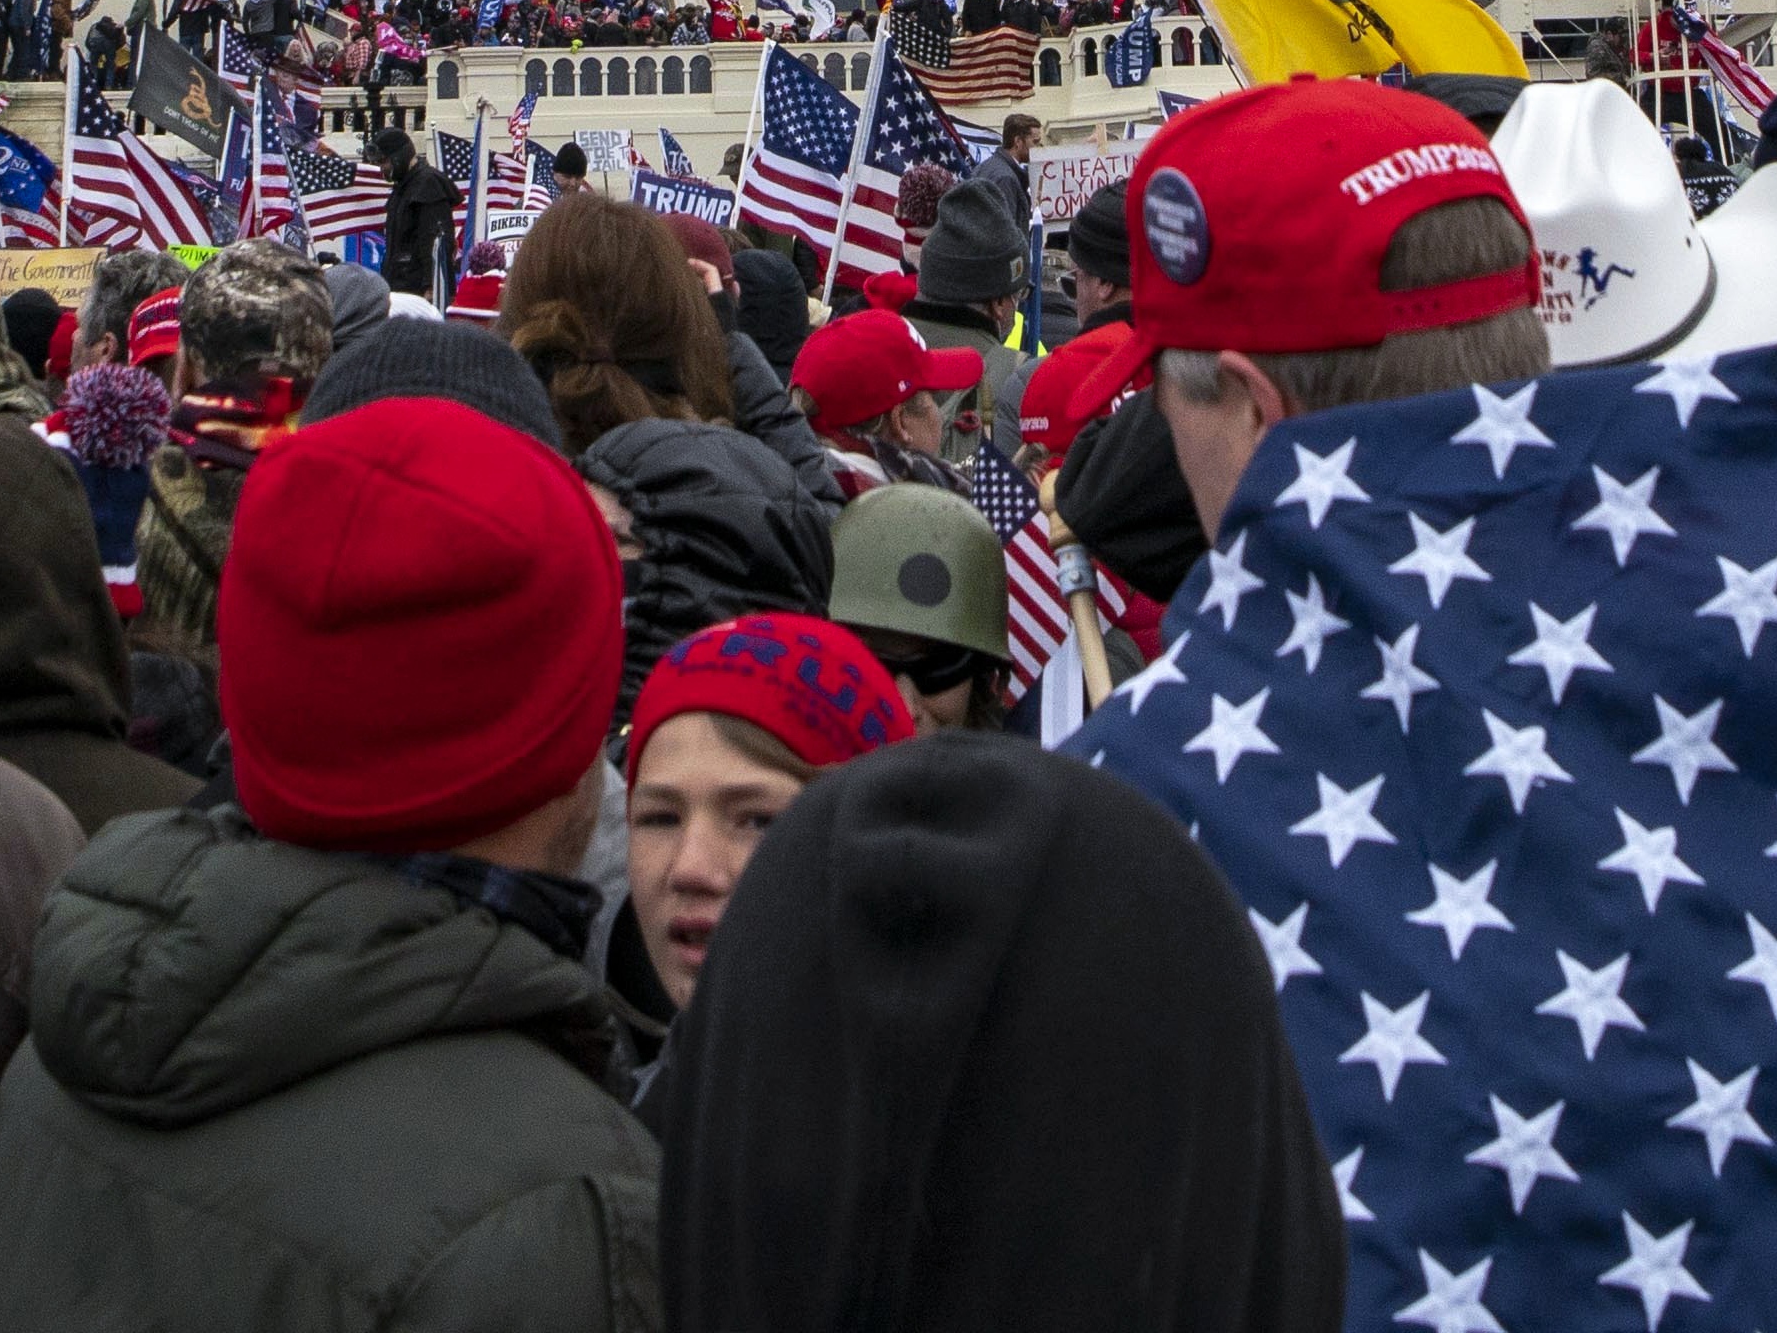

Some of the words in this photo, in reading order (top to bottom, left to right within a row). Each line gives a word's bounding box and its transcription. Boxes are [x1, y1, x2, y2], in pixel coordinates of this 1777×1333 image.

[579, 130, 623, 148] SEND
[640, 181, 734, 224] TRUMP
[489, 213, 529, 233] BIKERS
